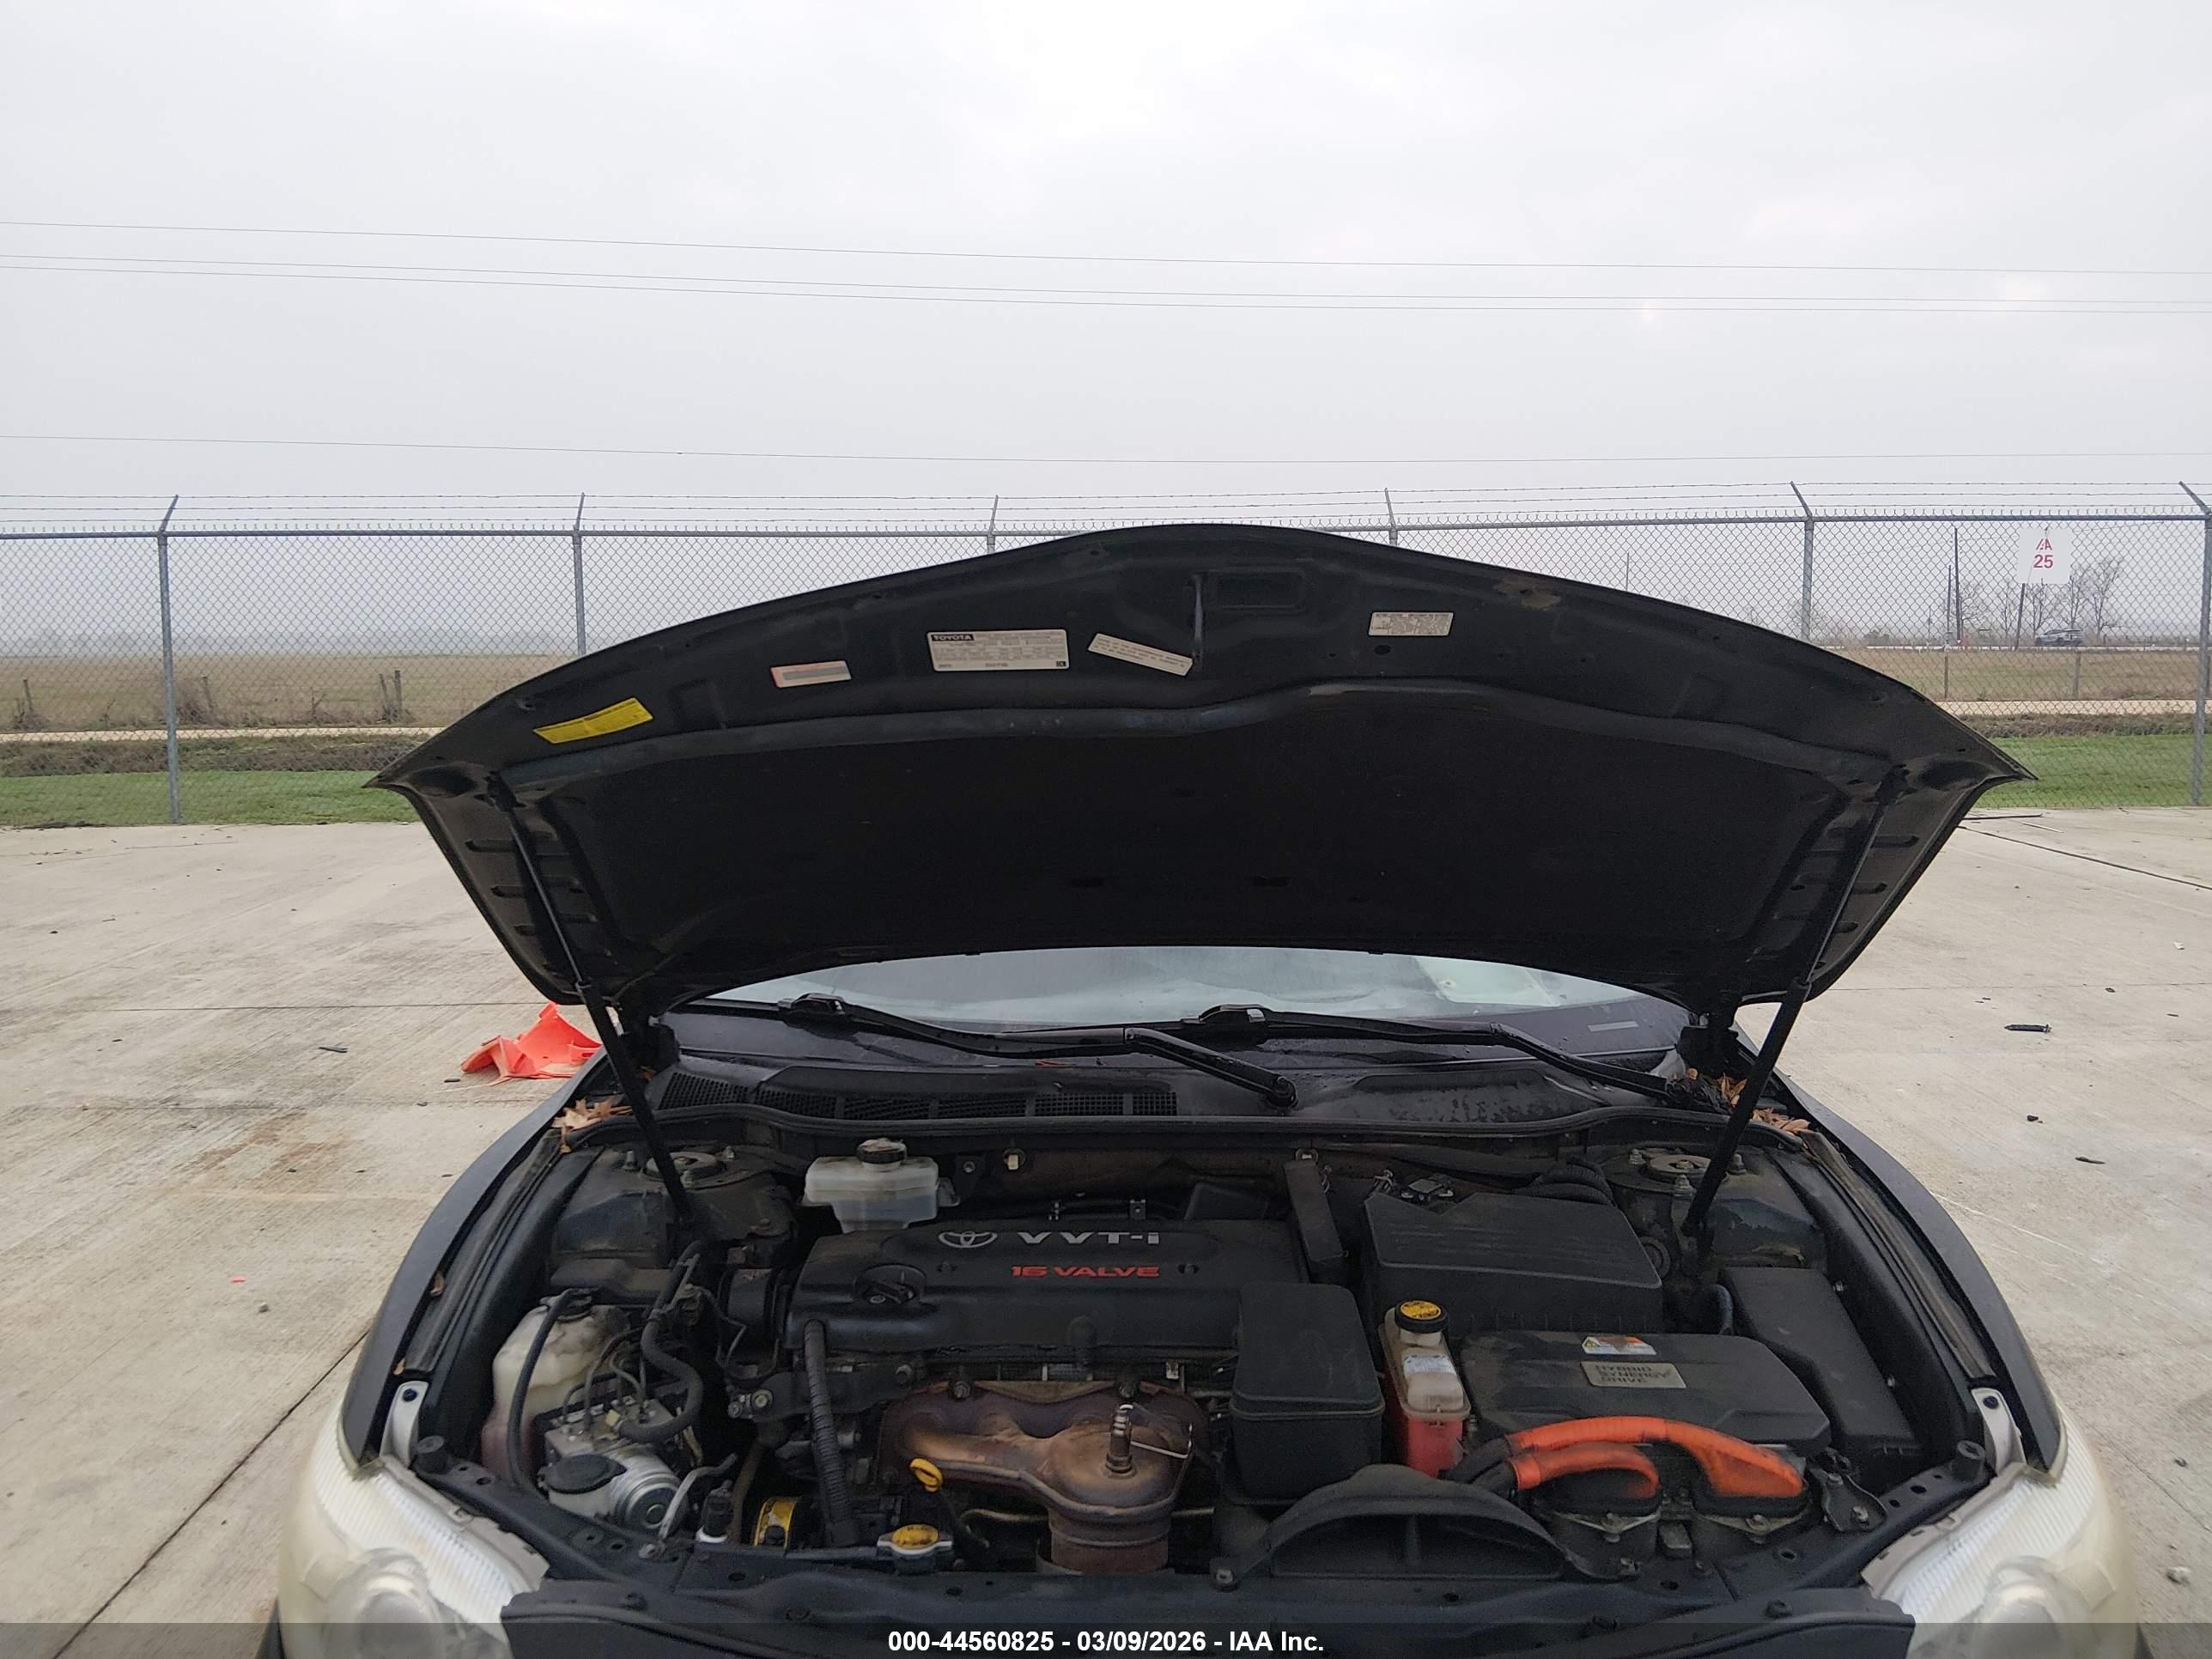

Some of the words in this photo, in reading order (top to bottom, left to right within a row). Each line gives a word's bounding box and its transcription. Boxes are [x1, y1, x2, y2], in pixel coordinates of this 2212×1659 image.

[2033, 554, 2054, 568] 25
[1017, 1231, 1160, 1244] VVT-i
[1011, 1266, 1048, 1278] 16
[1054, 1266, 1160, 1278] VALVE
